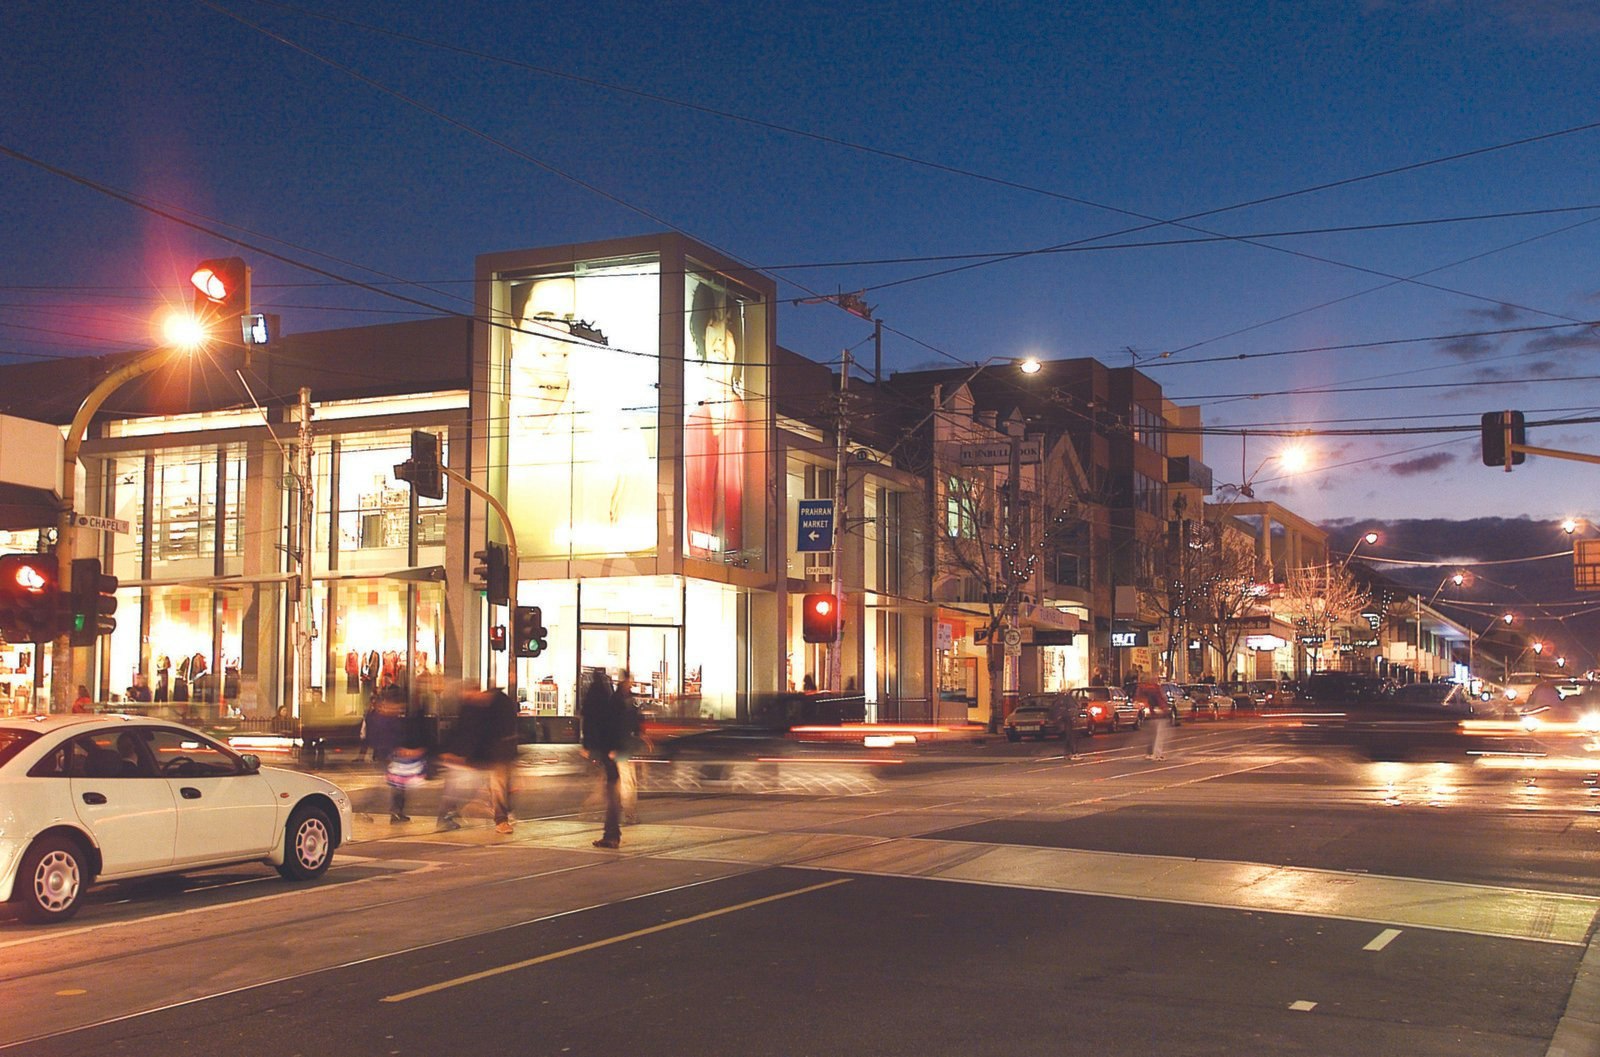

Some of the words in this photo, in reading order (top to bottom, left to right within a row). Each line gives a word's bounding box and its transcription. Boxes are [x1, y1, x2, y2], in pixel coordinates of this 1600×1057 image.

[800, 508, 832, 516] PRAHRAN
[89, 517, 121, 531] CHAPEL
[803, 520, 829, 528] MARKET
